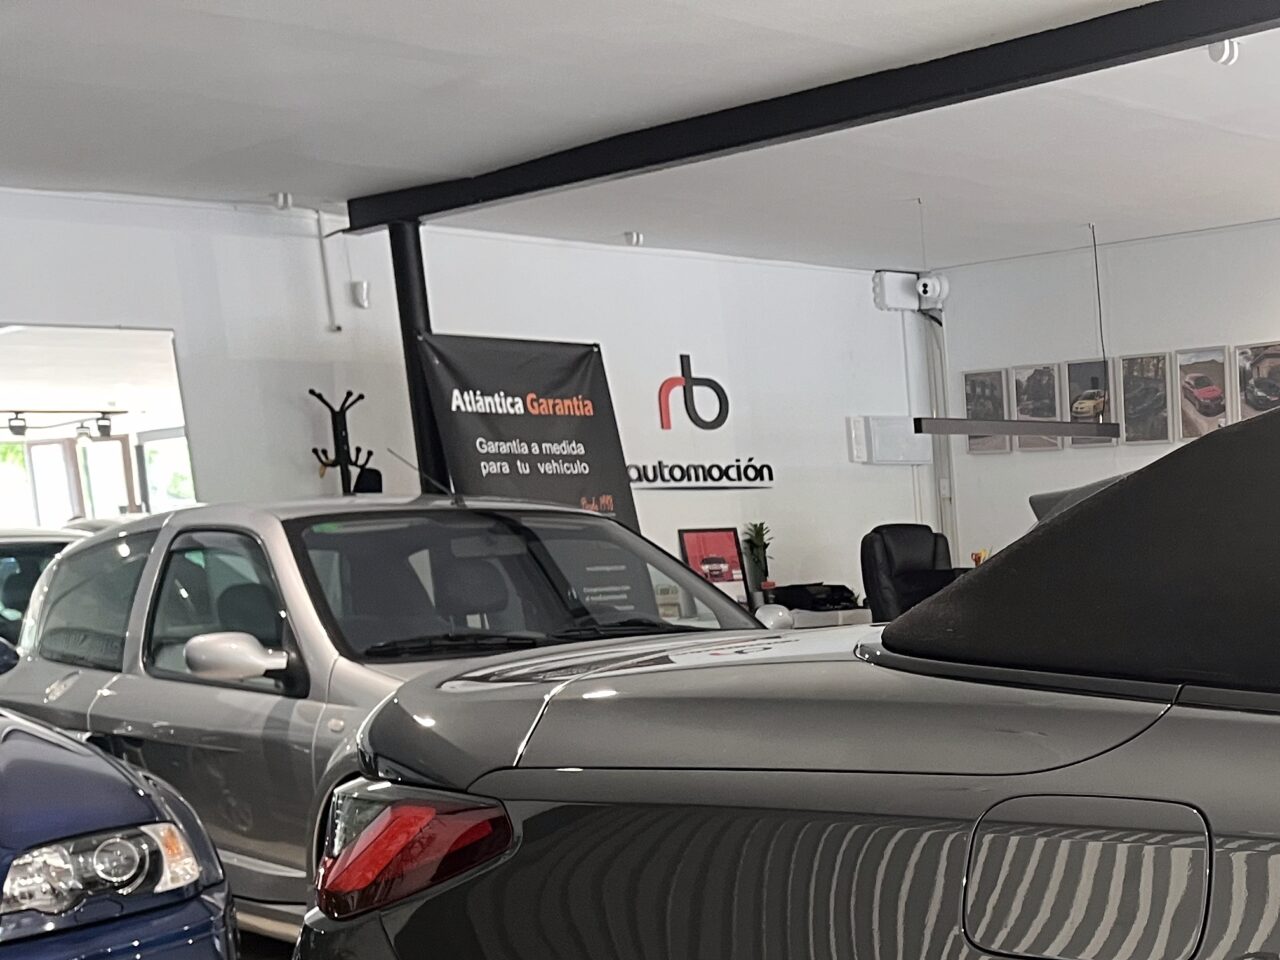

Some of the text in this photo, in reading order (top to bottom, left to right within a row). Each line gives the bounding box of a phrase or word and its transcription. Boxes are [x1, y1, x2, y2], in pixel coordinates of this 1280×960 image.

[451, 388, 594, 416] Atlántica Garantía
[658, 353, 730, 431] rb
[476, 437, 586, 456] Garantía a medida
[480, 459, 590, 477] para tu vehículo
[626, 457, 774, 483] automoción
